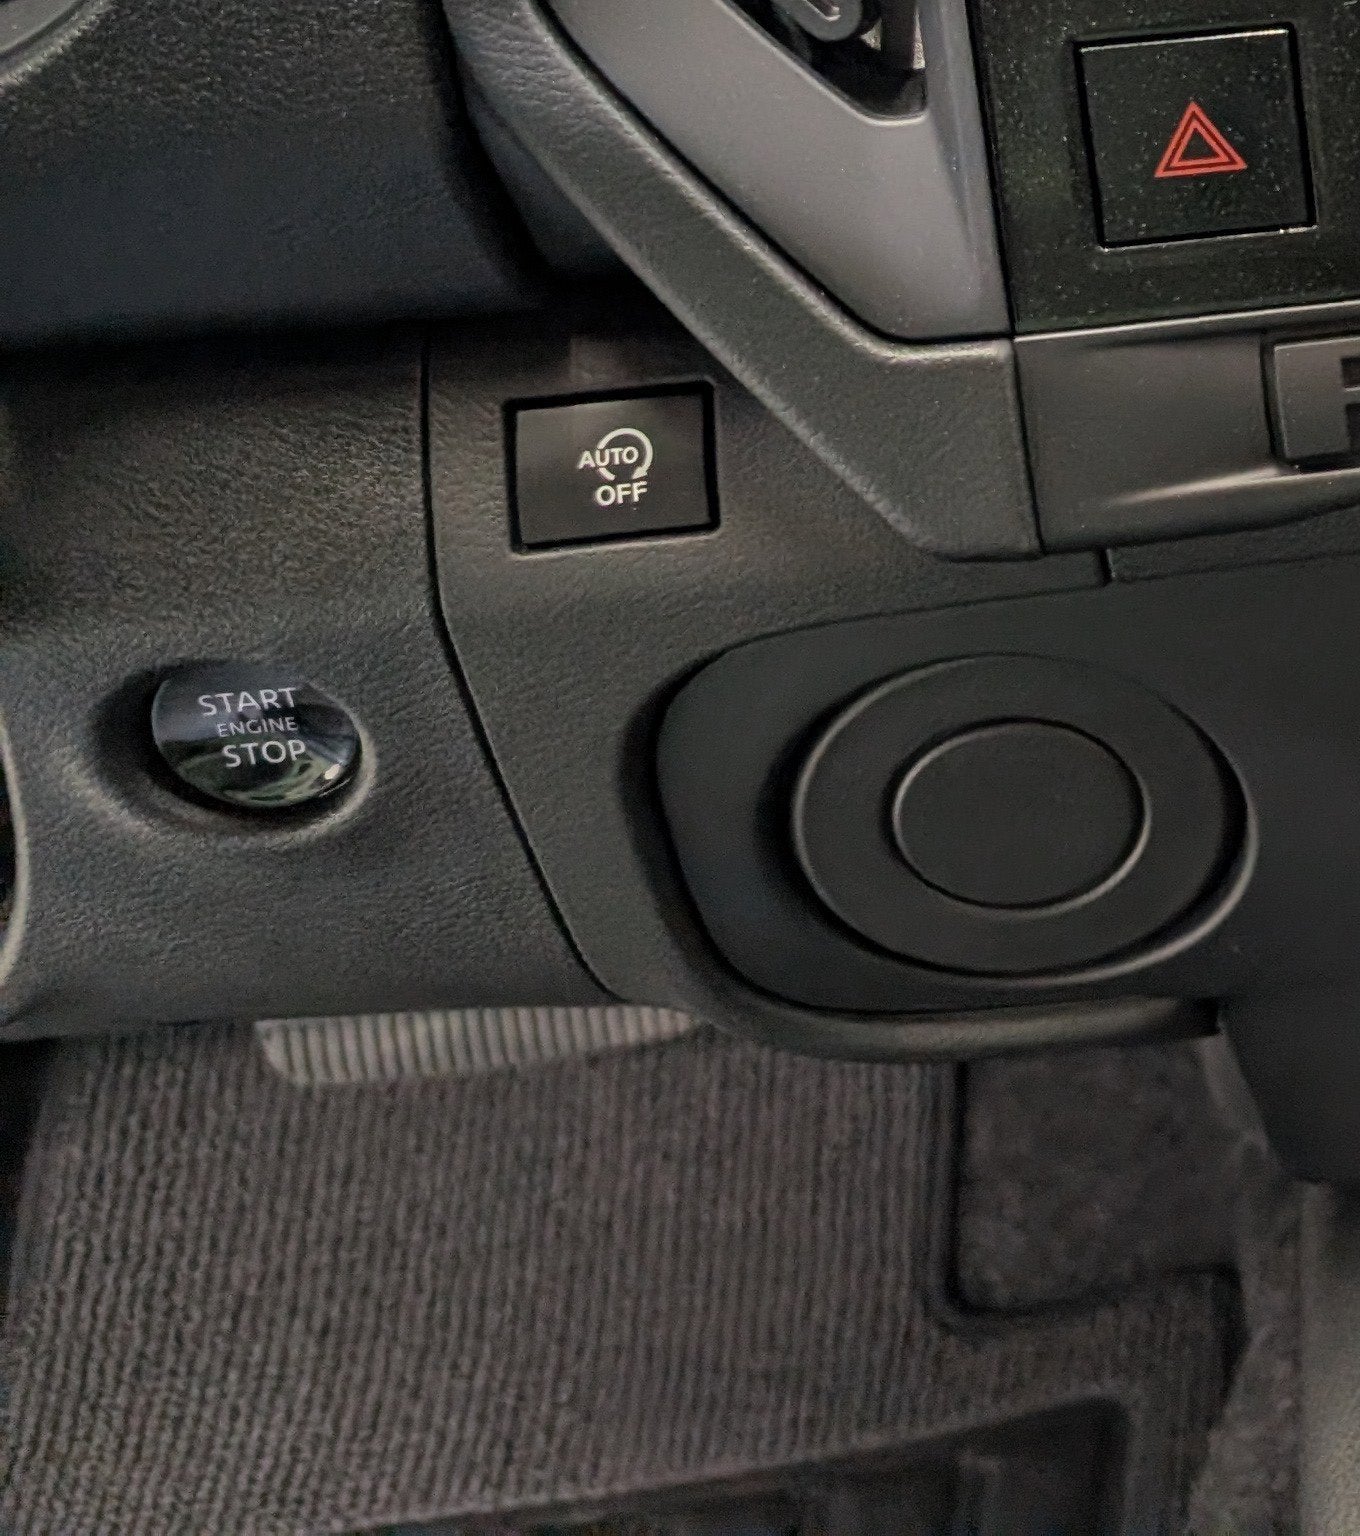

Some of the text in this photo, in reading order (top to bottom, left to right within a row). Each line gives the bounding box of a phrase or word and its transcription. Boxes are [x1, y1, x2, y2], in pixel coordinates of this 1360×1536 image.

[578, 445, 640, 472] AUTO
[594, 481, 648, 507] OFF
[198, 687, 297, 717] START
[216, 716, 298, 740] ENGINE
[221, 738, 306, 769] STOP
